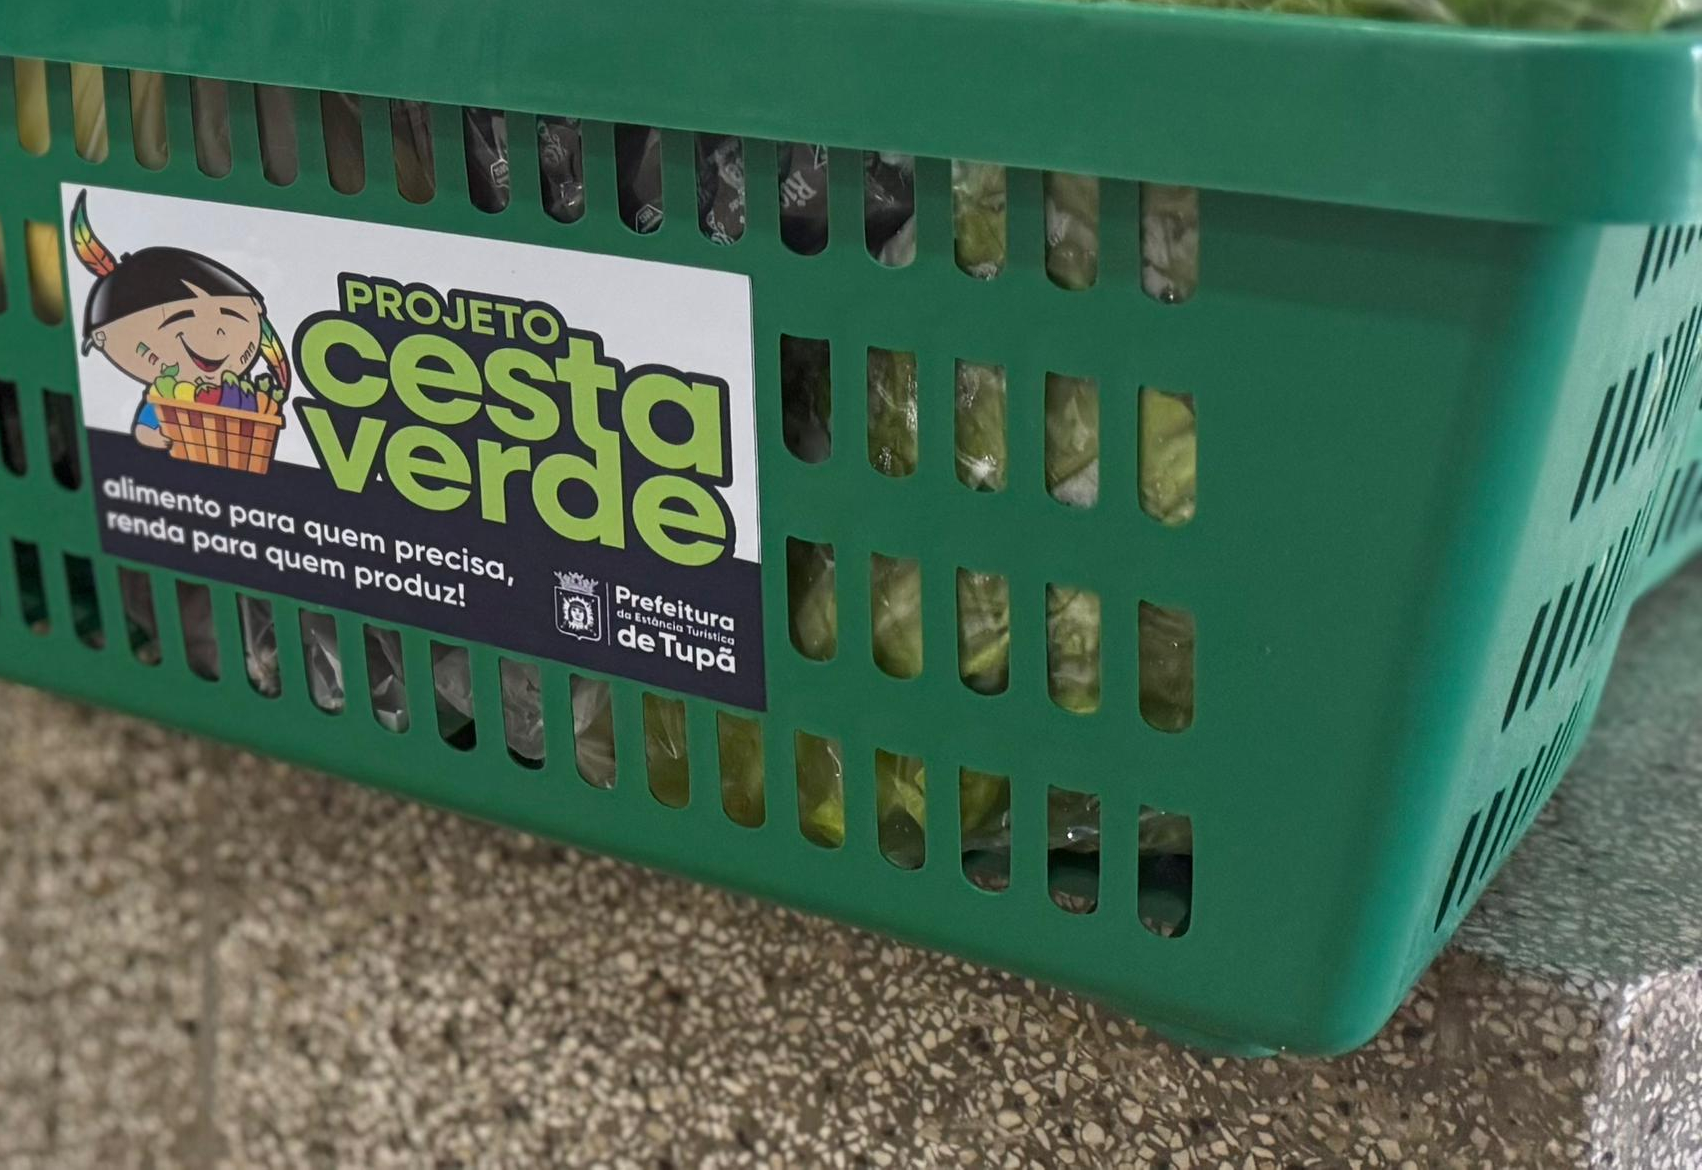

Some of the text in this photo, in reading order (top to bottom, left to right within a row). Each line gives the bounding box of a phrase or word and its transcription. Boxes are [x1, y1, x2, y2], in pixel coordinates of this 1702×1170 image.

[346, 280, 560, 345] PROJETO
[300, 319, 724, 478] cesta
[302, 406, 727, 566] verde
[103, 475, 514, 587] alimento para quem precisa,
[107, 510, 466, 608] renda para quem produz!
[616, 585, 735, 631] Prefeitura
[616, 609, 632, 620] da
[617, 624, 736, 674] de Tupã
